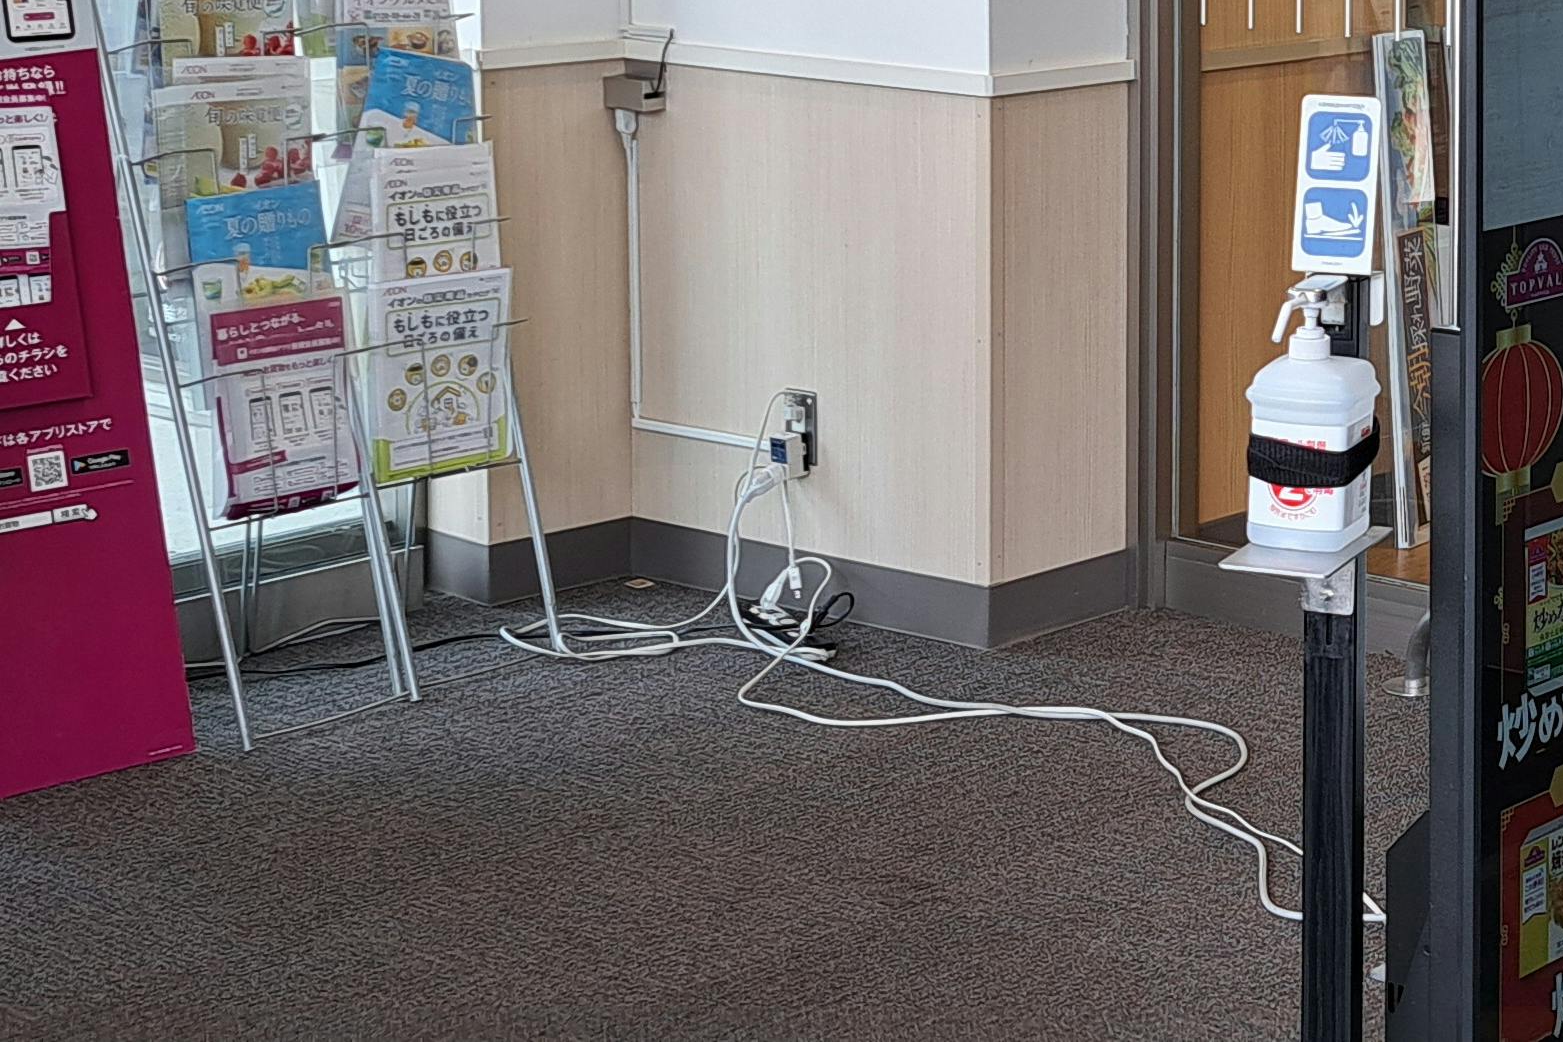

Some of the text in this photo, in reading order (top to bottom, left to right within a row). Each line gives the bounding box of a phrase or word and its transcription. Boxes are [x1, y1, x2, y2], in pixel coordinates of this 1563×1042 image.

[394, 205, 482, 227] もしもに役立つ
[393, 308, 489, 334] もしもに役立つ
[0, 332, 42, 349] しくは
[0, 418, 113, 447] は各アプリストアで
